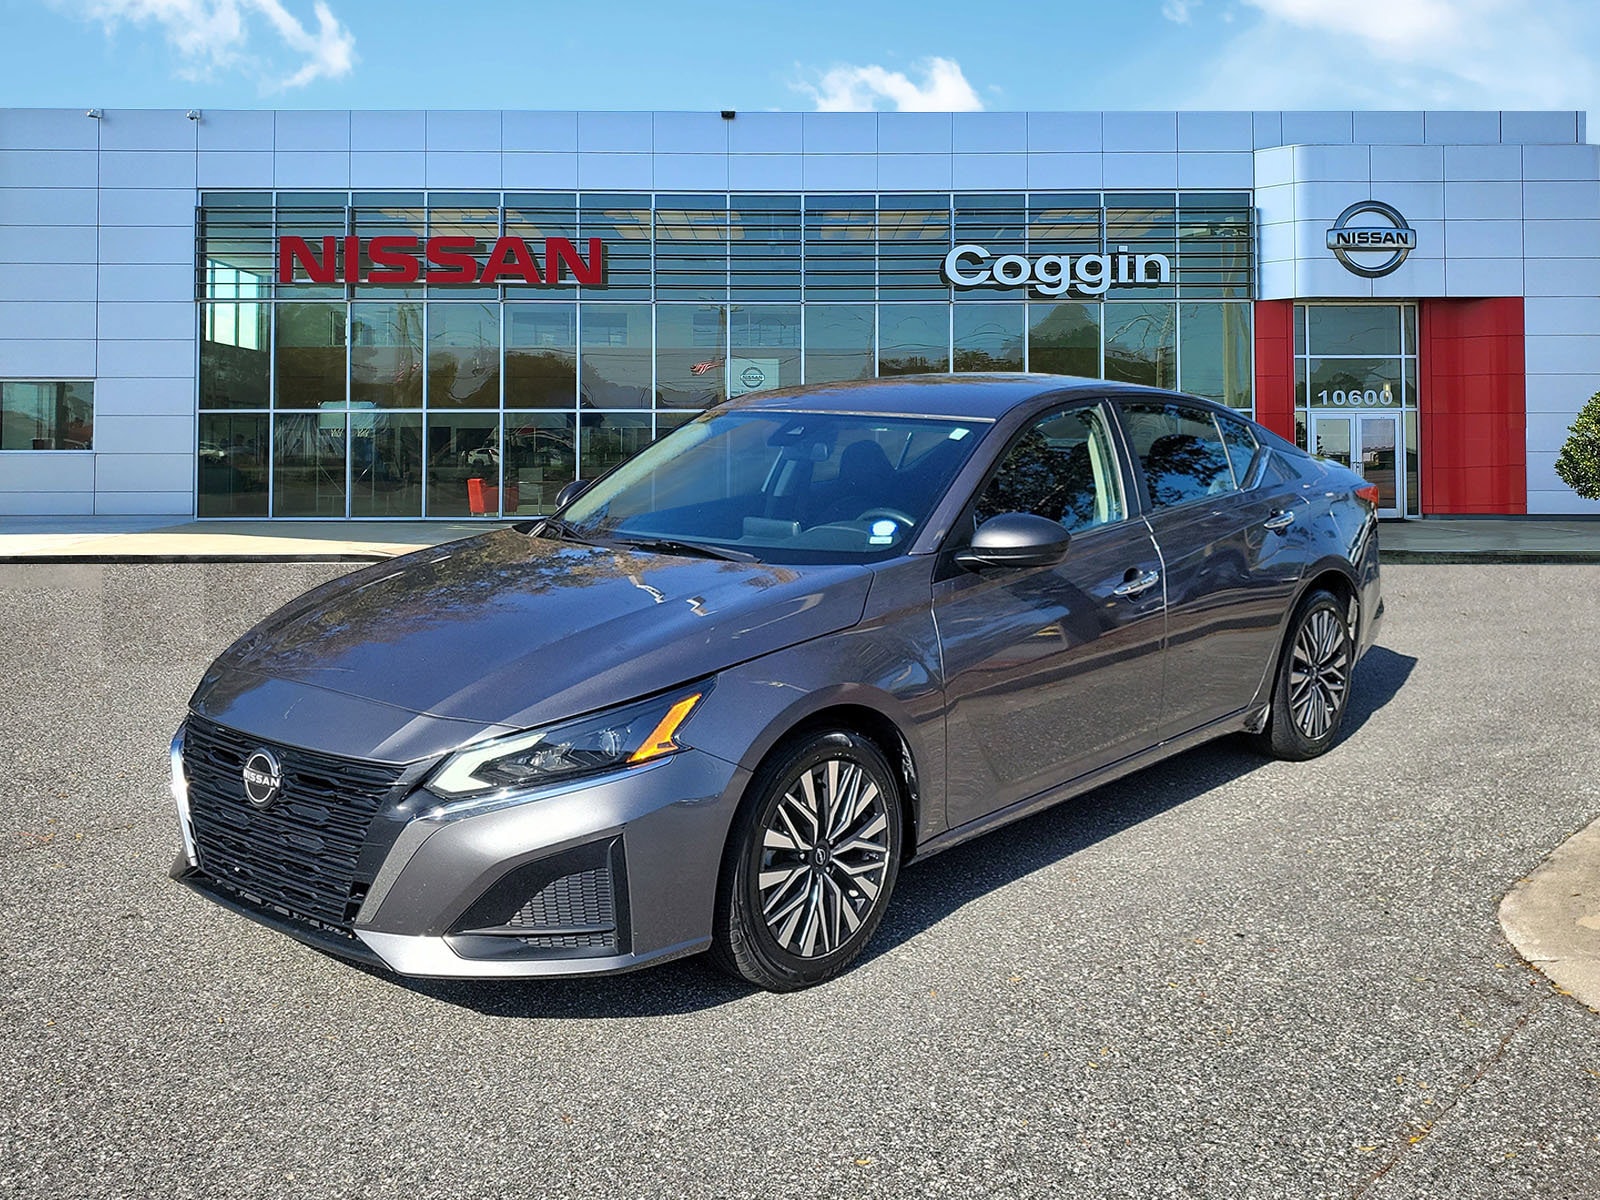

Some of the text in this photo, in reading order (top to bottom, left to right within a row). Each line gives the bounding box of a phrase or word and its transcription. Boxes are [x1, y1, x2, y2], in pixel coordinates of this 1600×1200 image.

[1336, 232, 1408, 245] NISSAN
[279, 235, 602, 284] NISSAN
[944, 244, 1171, 295] Coggin
[1317, 389, 1393, 406] 10600
